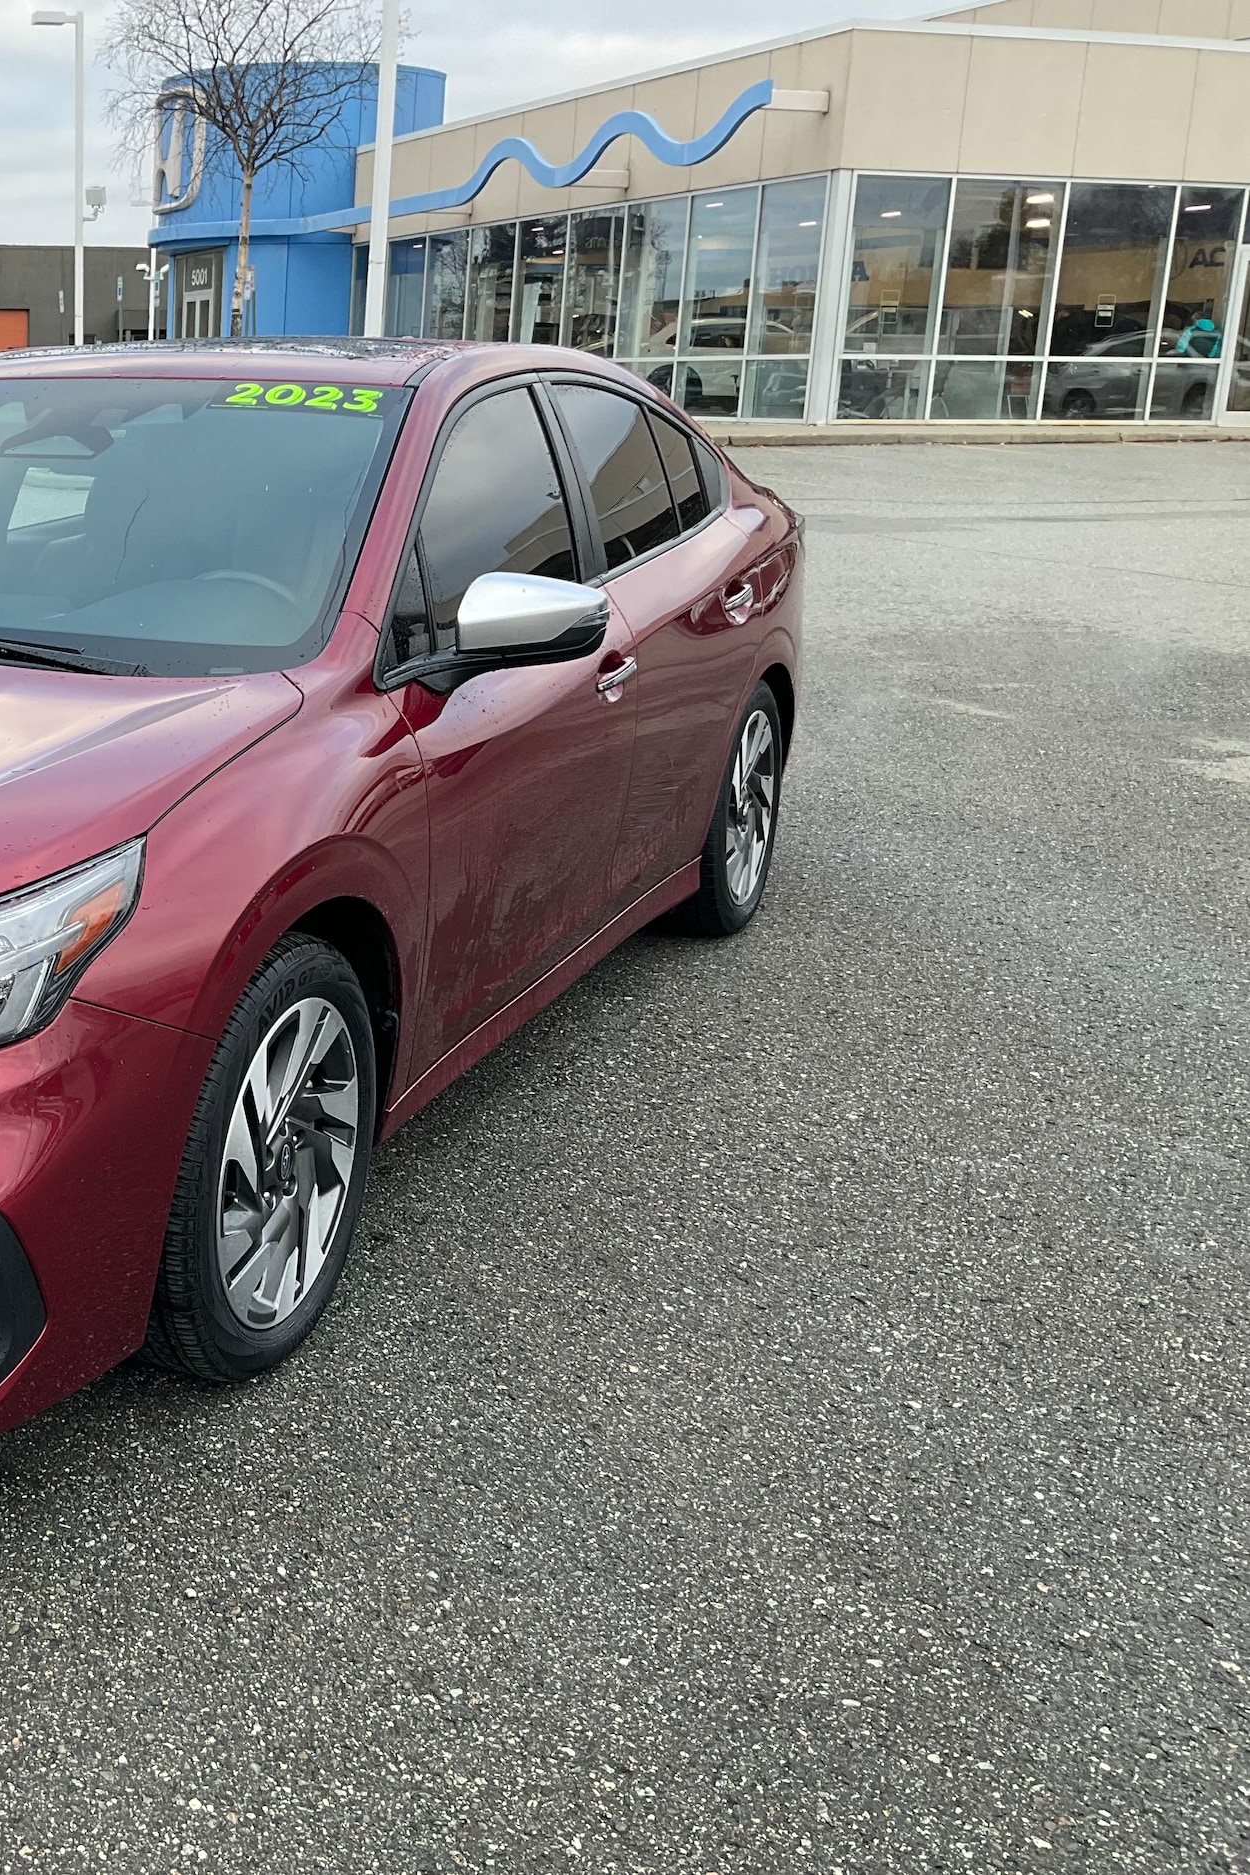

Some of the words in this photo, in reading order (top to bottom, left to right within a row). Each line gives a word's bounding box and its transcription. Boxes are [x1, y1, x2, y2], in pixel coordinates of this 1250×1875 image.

[191, 268, 208, 286] 5001
[225, 383, 383, 412] 2023
[299, 966, 316, 987] GT
